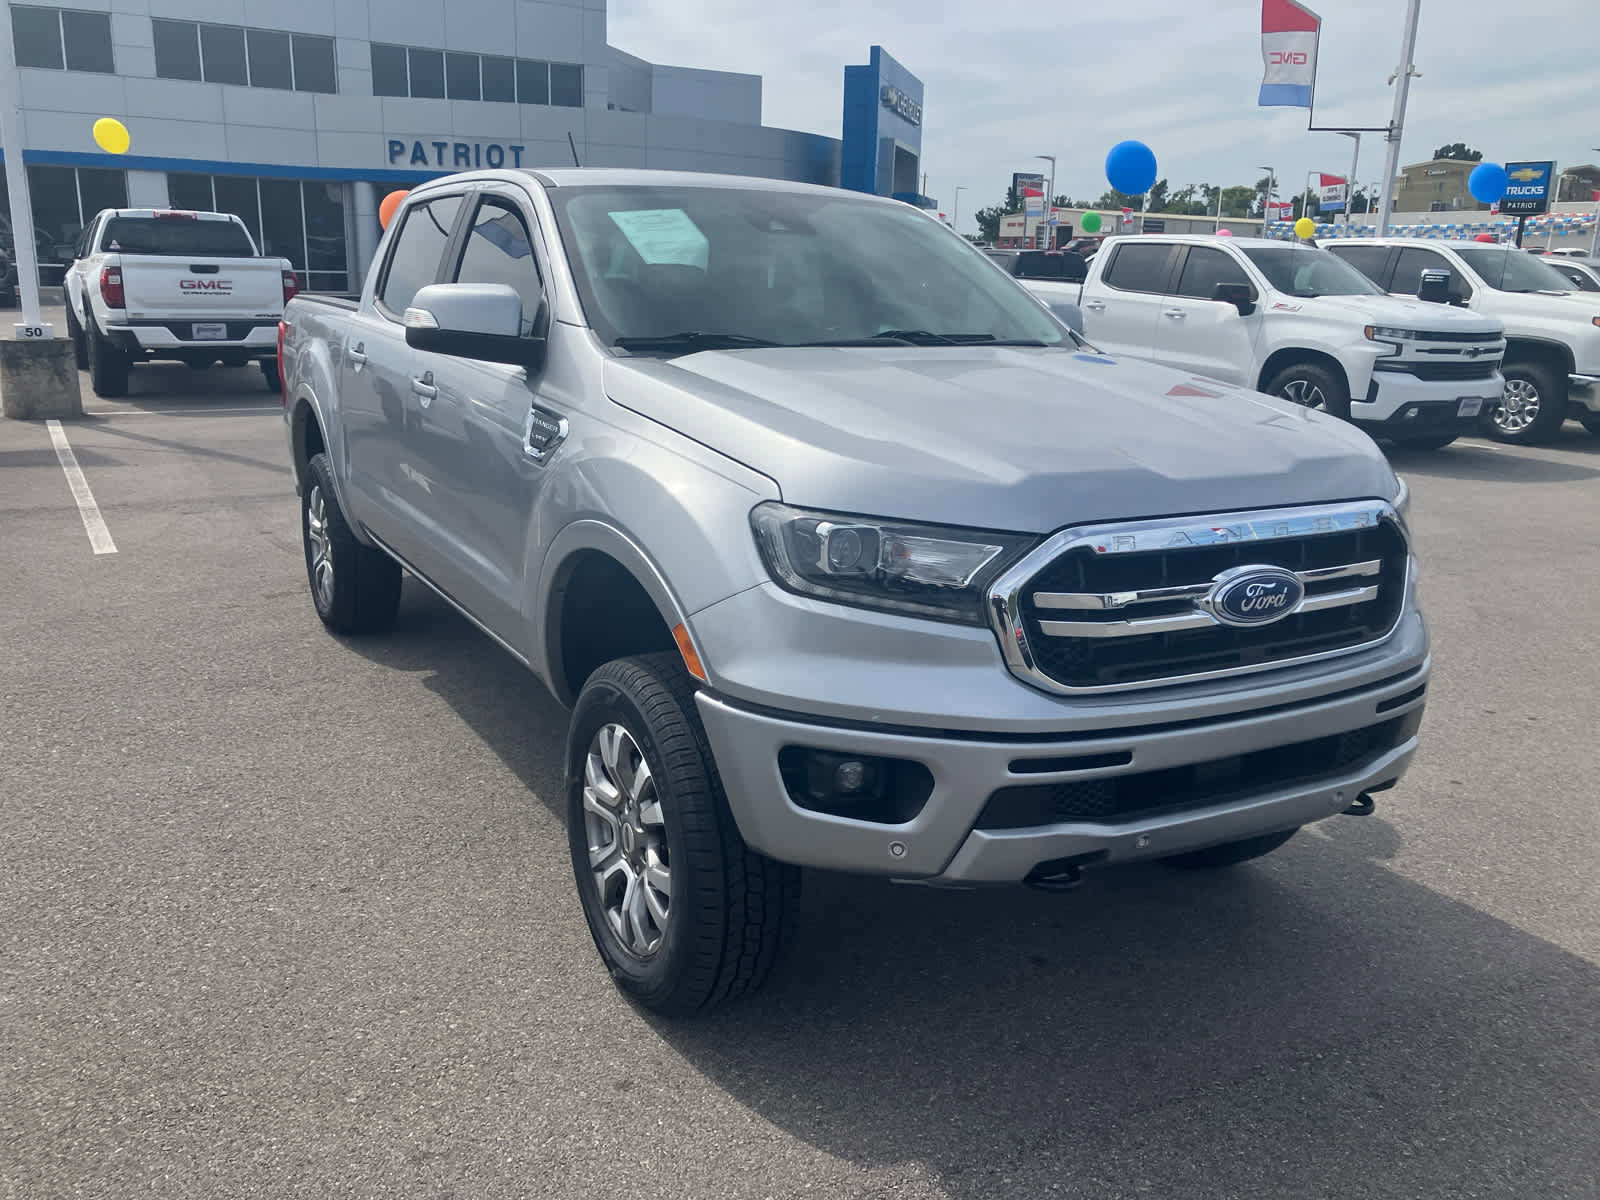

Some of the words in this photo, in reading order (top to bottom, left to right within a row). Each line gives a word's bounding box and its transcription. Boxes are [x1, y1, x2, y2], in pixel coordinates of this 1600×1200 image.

[388, 139, 526, 169] PATRIOT
[1505, 185, 1545, 195] TRUCKS
[1507, 201, 1537, 209] PATRIOT
[179, 279, 233, 291] GMC
[24, 327, 43, 338] 50
[534, 417, 559, 433] RANGER
[1239, 582, 1288, 612] Ford
